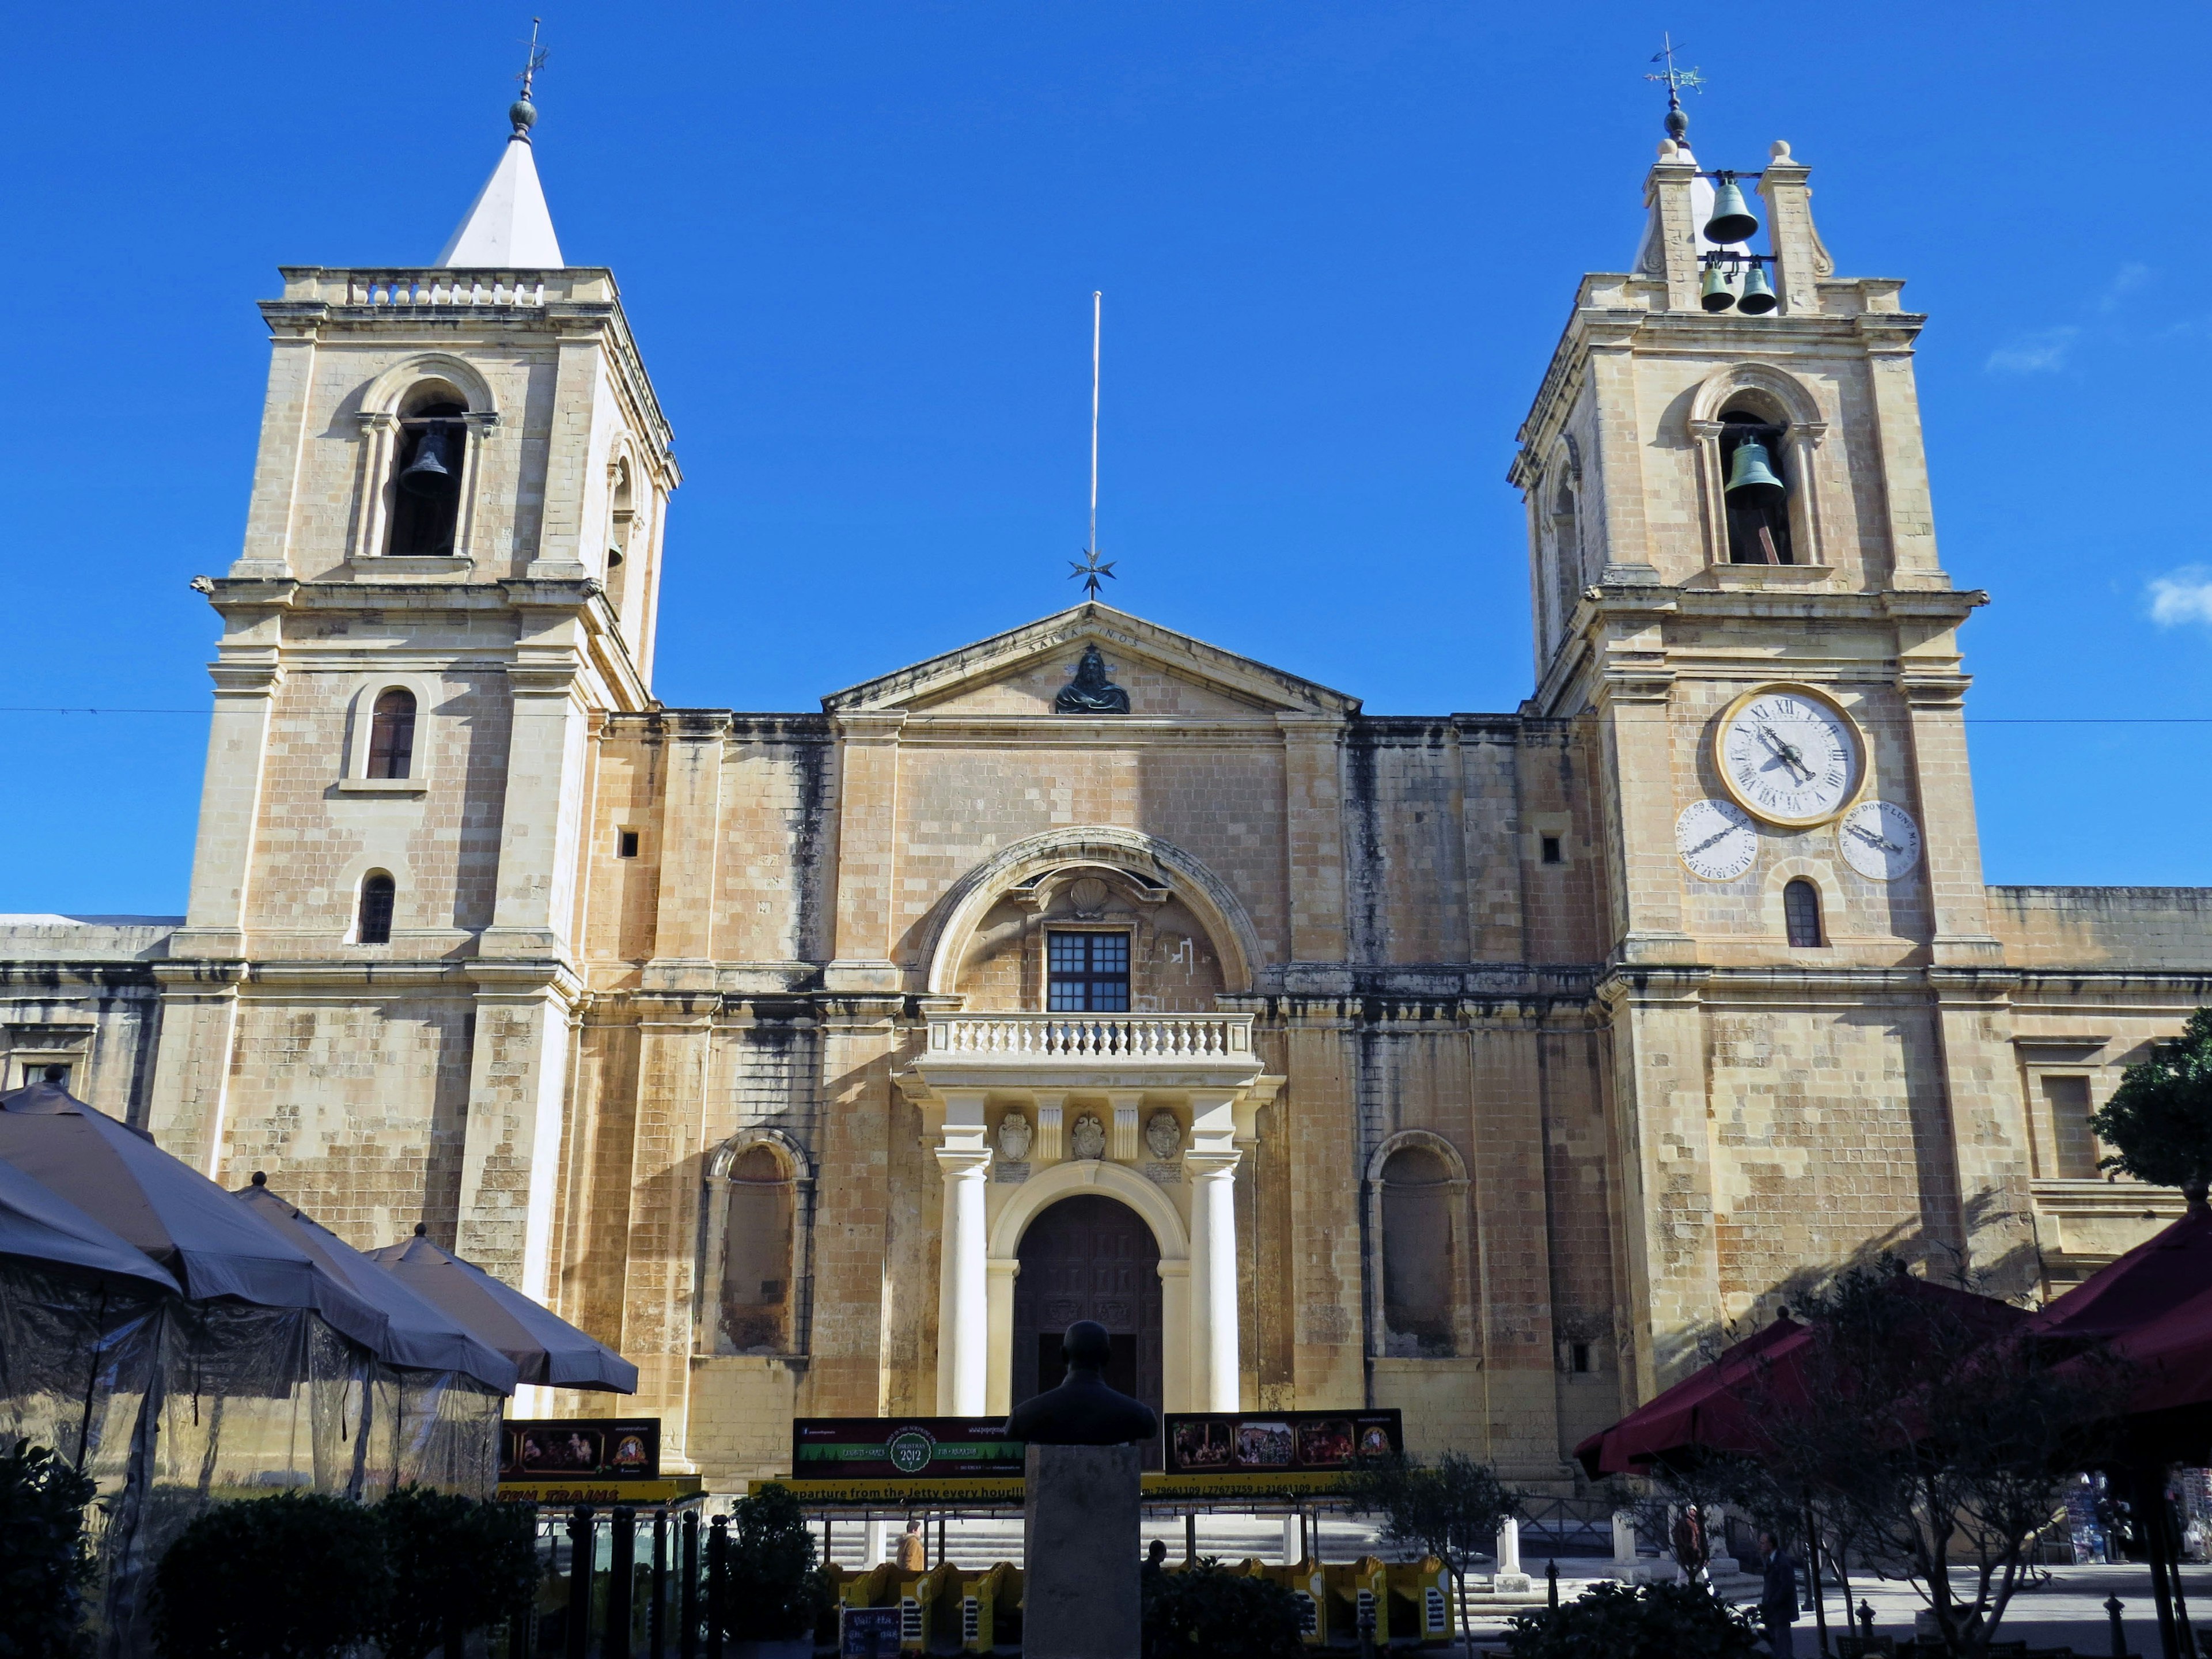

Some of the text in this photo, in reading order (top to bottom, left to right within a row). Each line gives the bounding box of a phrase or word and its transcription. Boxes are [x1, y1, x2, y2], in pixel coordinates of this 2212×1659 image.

[1751, 704, 1769, 721] XI
[1775, 699, 1794, 715] XII
[1734, 724, 1751, 737] X
[1832, 750, 1848, 760] III
[1815, 791, 1827, 805] V
[1688, 861, 1698, 870] 19
[1742, 857, 1751, 866] 11
[1701, 869, 1711, 877] 17
[900, 1450, 921, 1461] 2012
[851, 1488, 880, 1497] from
[884, 1487, 904, 1497] the
[907, 1488, 939, 1498] Jetty
[942, 1489, 978, 1498] every
[982, 1487, 1023, 1497] hour!!!
[1156, 1486, 1200, 1494] 79661109
[1206, 1485, 1253, 1494] 77673759
[1266, 1484, 1310, 1493] 21661109
[498, 1489, 619, 1502] FUN TRAINS
